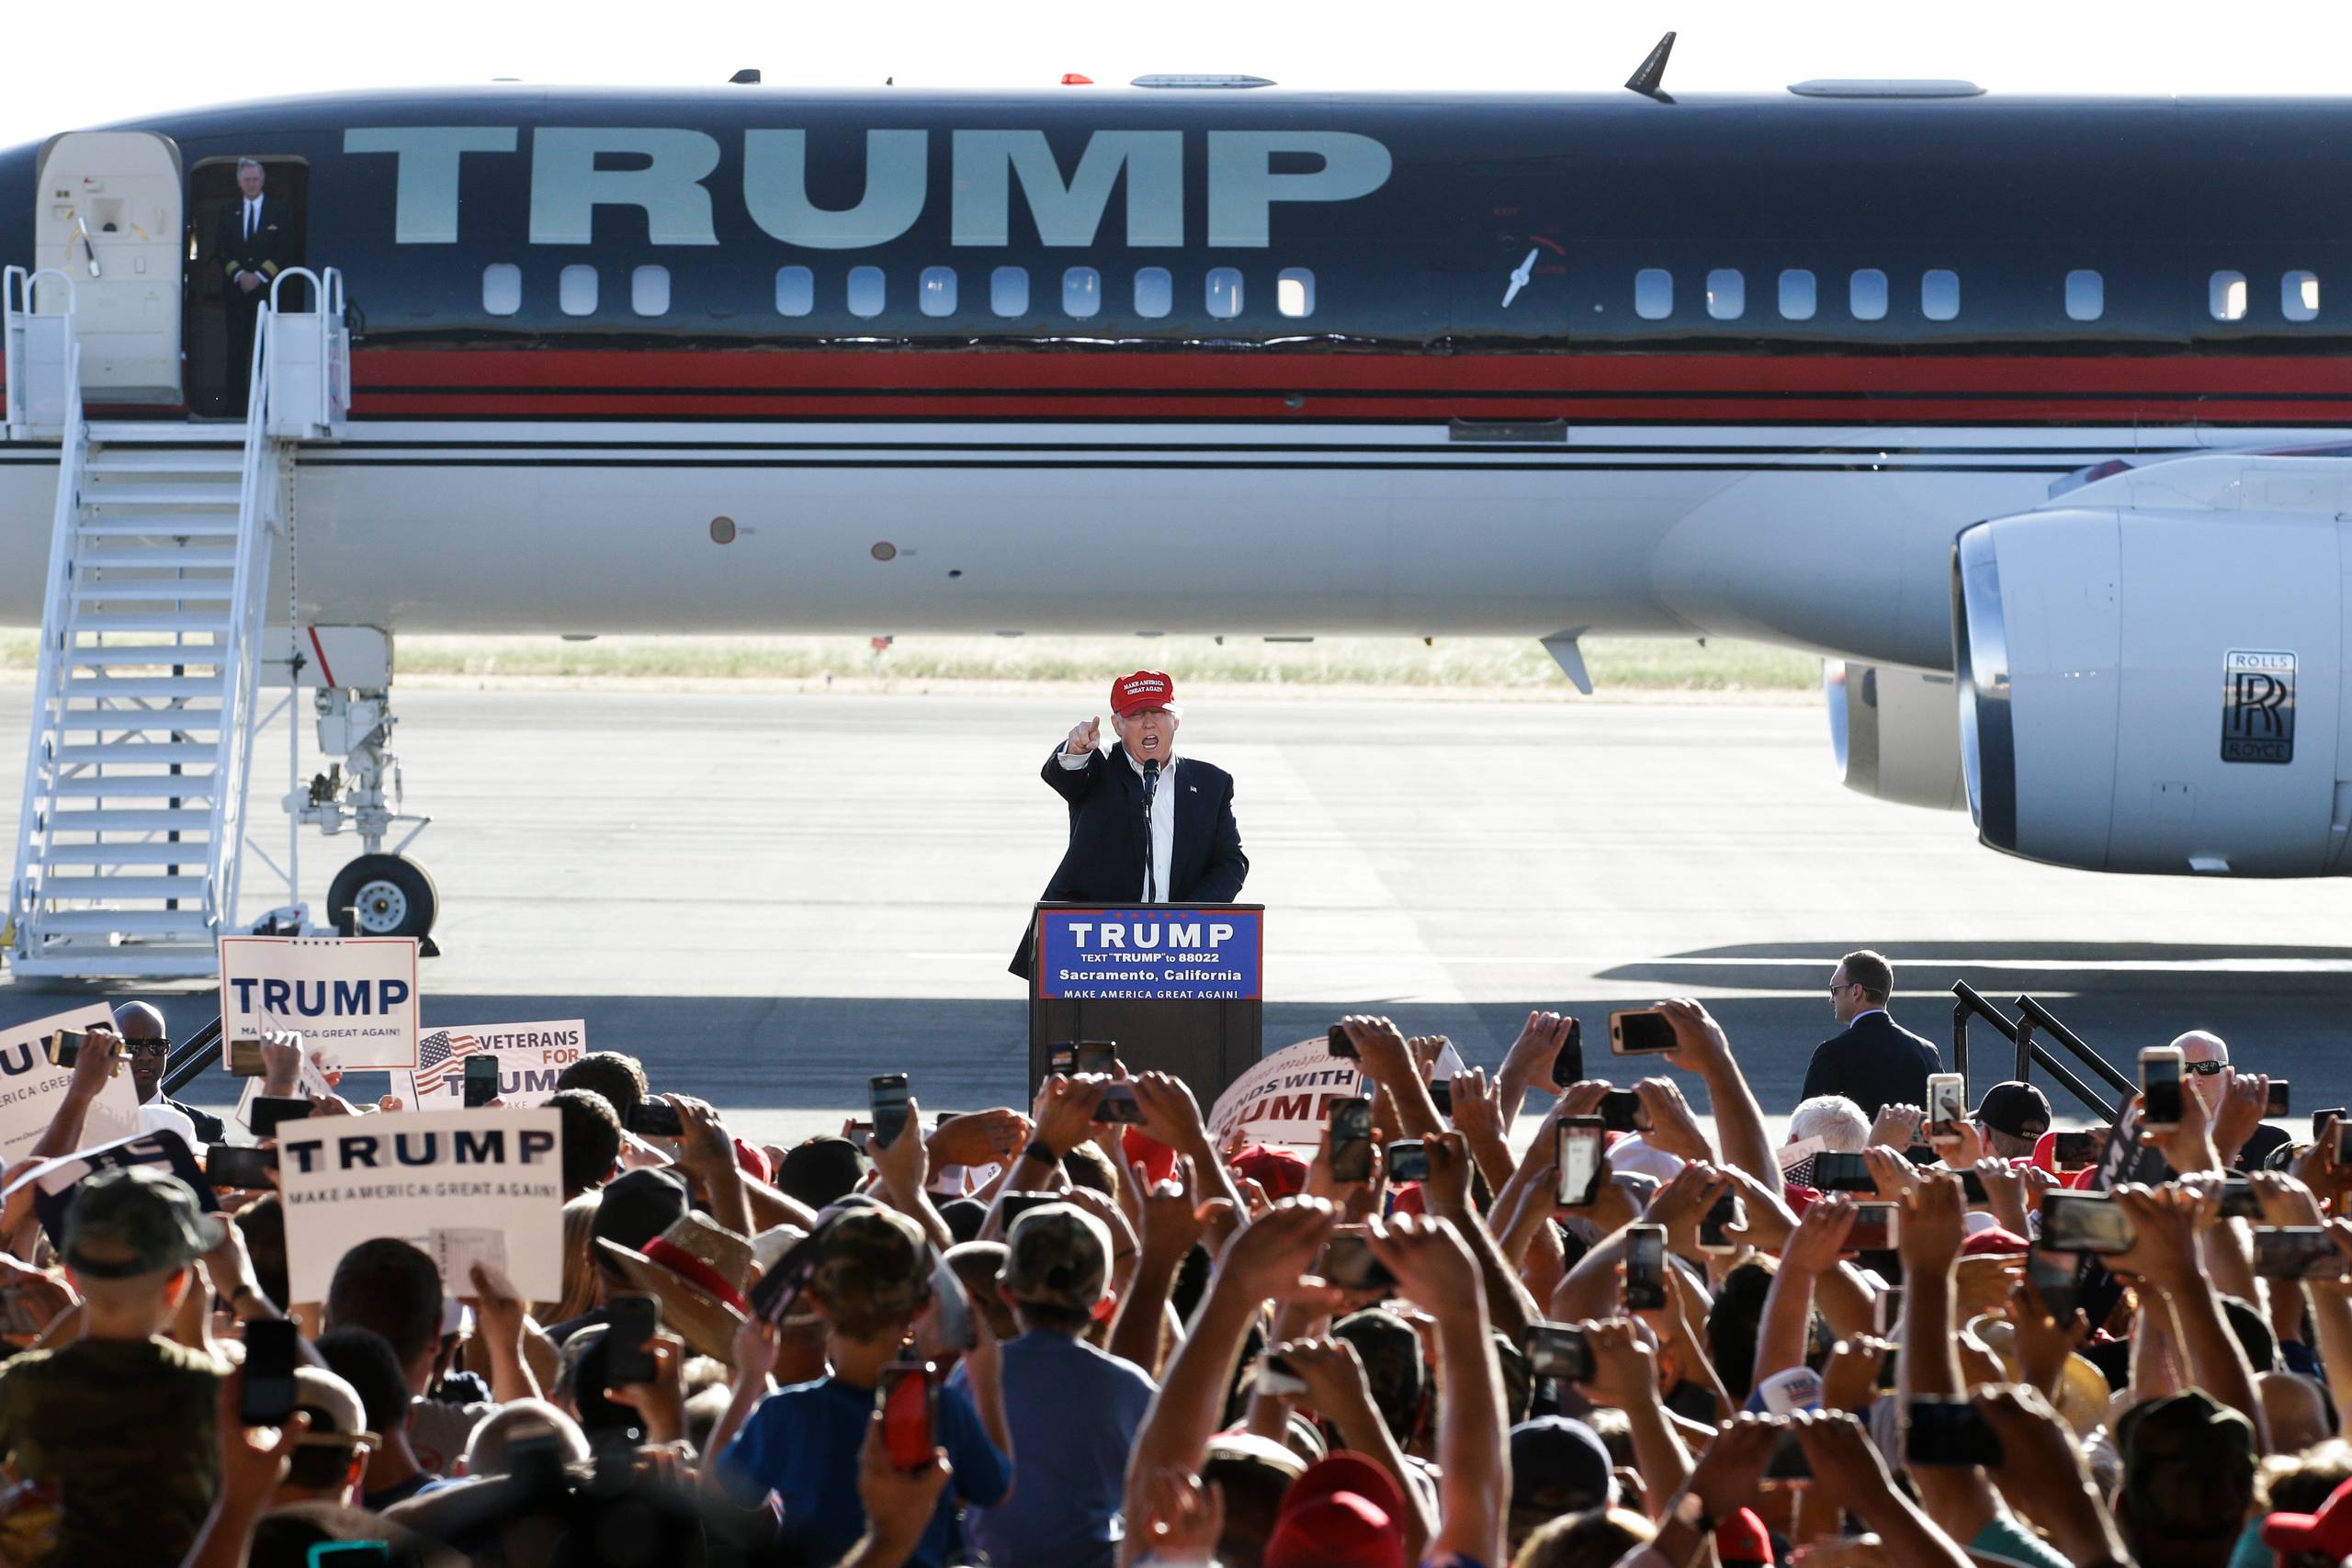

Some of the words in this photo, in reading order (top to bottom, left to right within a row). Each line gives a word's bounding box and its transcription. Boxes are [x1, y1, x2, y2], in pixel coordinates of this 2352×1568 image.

[343, 127, 1393, 249] TRUMP
[2235, 655, 2287, 667] ROLLS
[1124, 681, 1139, 690] MAKE
[2229, 743, 2285, 757] ROYCE
[1069, 923, 1234, 948] TRUMP
[1080, 953, 1107, 963] TEXT
[1109, 953, 1166, 963] "TRUMP"
[1166, 953, 1176, 963] to
[1179, 953, 1219, 963] 88022
[1059, 969, 1159, 981] Sacramento,
[1165, 969, 1242, 981] California
[231, 978, 409, 1017] TRUMP
[1064, 990, 1096, 998] MAKE
[1100, 990, 1152, 998] AMERICA
[1157, 990, 1193, 998] GREAT
[1197, 990, 1238, 998] AGAIN!
[322, 1029, 357, 1038] GREAT
[362, 1028, 401, 1036] AGAIN!
[479, 1031, 579, 1049] VETERANS
[543, 1049, 579, 1064] FOR
[41, 1076, 74, 1093] GREA
[443, 1069, 564, 1096] TUM
[1285, 1070, 1354, 1089] WITH
[286, 1131, 555, 1173] TRUMP
[289, 1189, 338, 1204] MAKE
[345, 1183, 428, 1198] AMERICA
[435, 1182, 491, 1196] GREAT
[496, 1183, 557, 1198] AGAIN!
